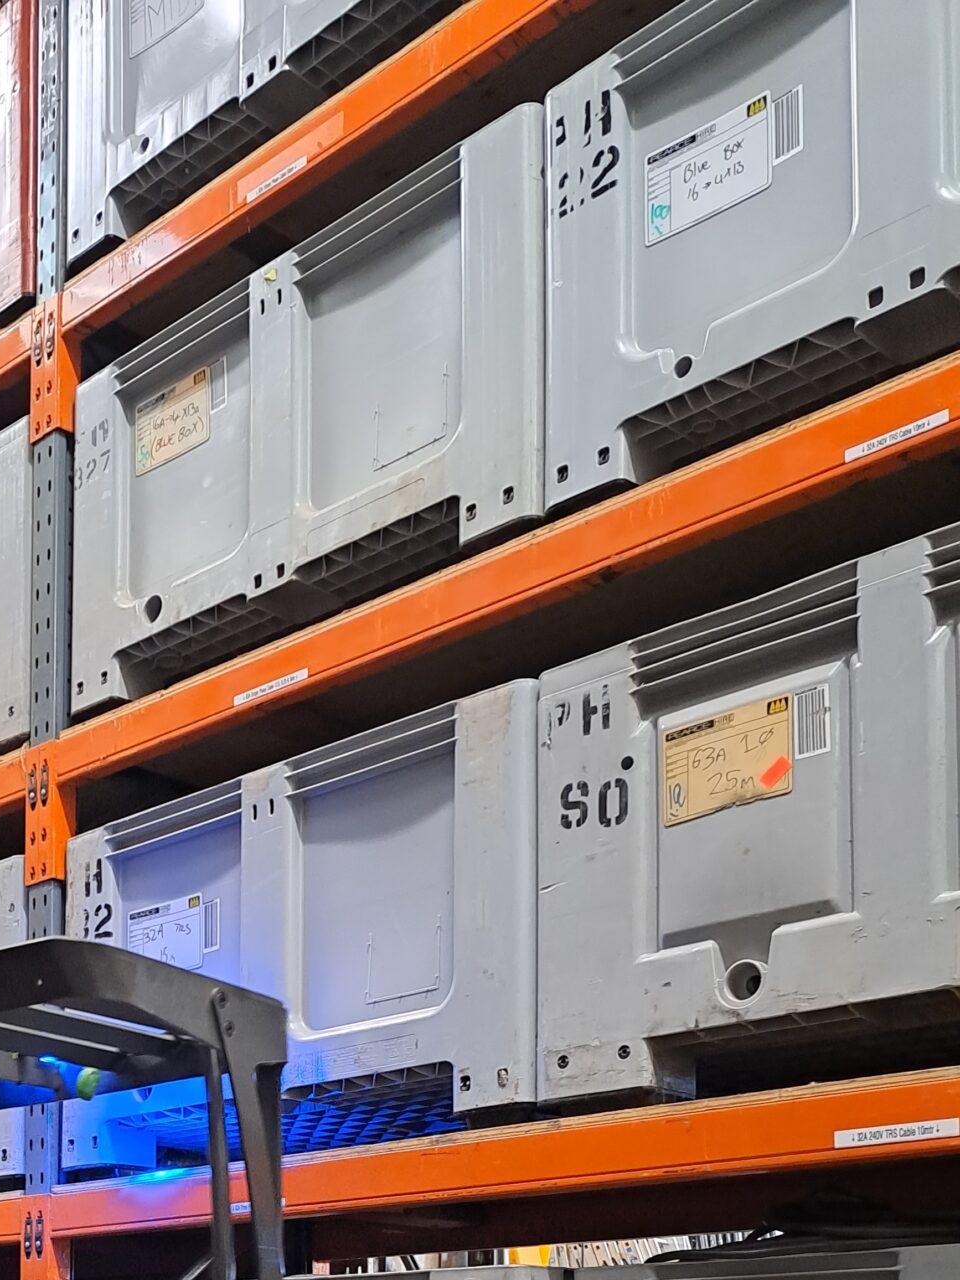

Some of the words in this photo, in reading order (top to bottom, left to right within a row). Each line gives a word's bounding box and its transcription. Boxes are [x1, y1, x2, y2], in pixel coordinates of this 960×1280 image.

[683, 160, 711, 184] Blue
[666, 719, 714, 742] PEARCE
[692, 747, 727, 771] 63A
[857, 1132, 868, 1142] 32A
[869, 1131, 884, 1141] 240V
[885, 1128, 898, 1139] TRS
[899, 1127, 916, 1138] Cable
